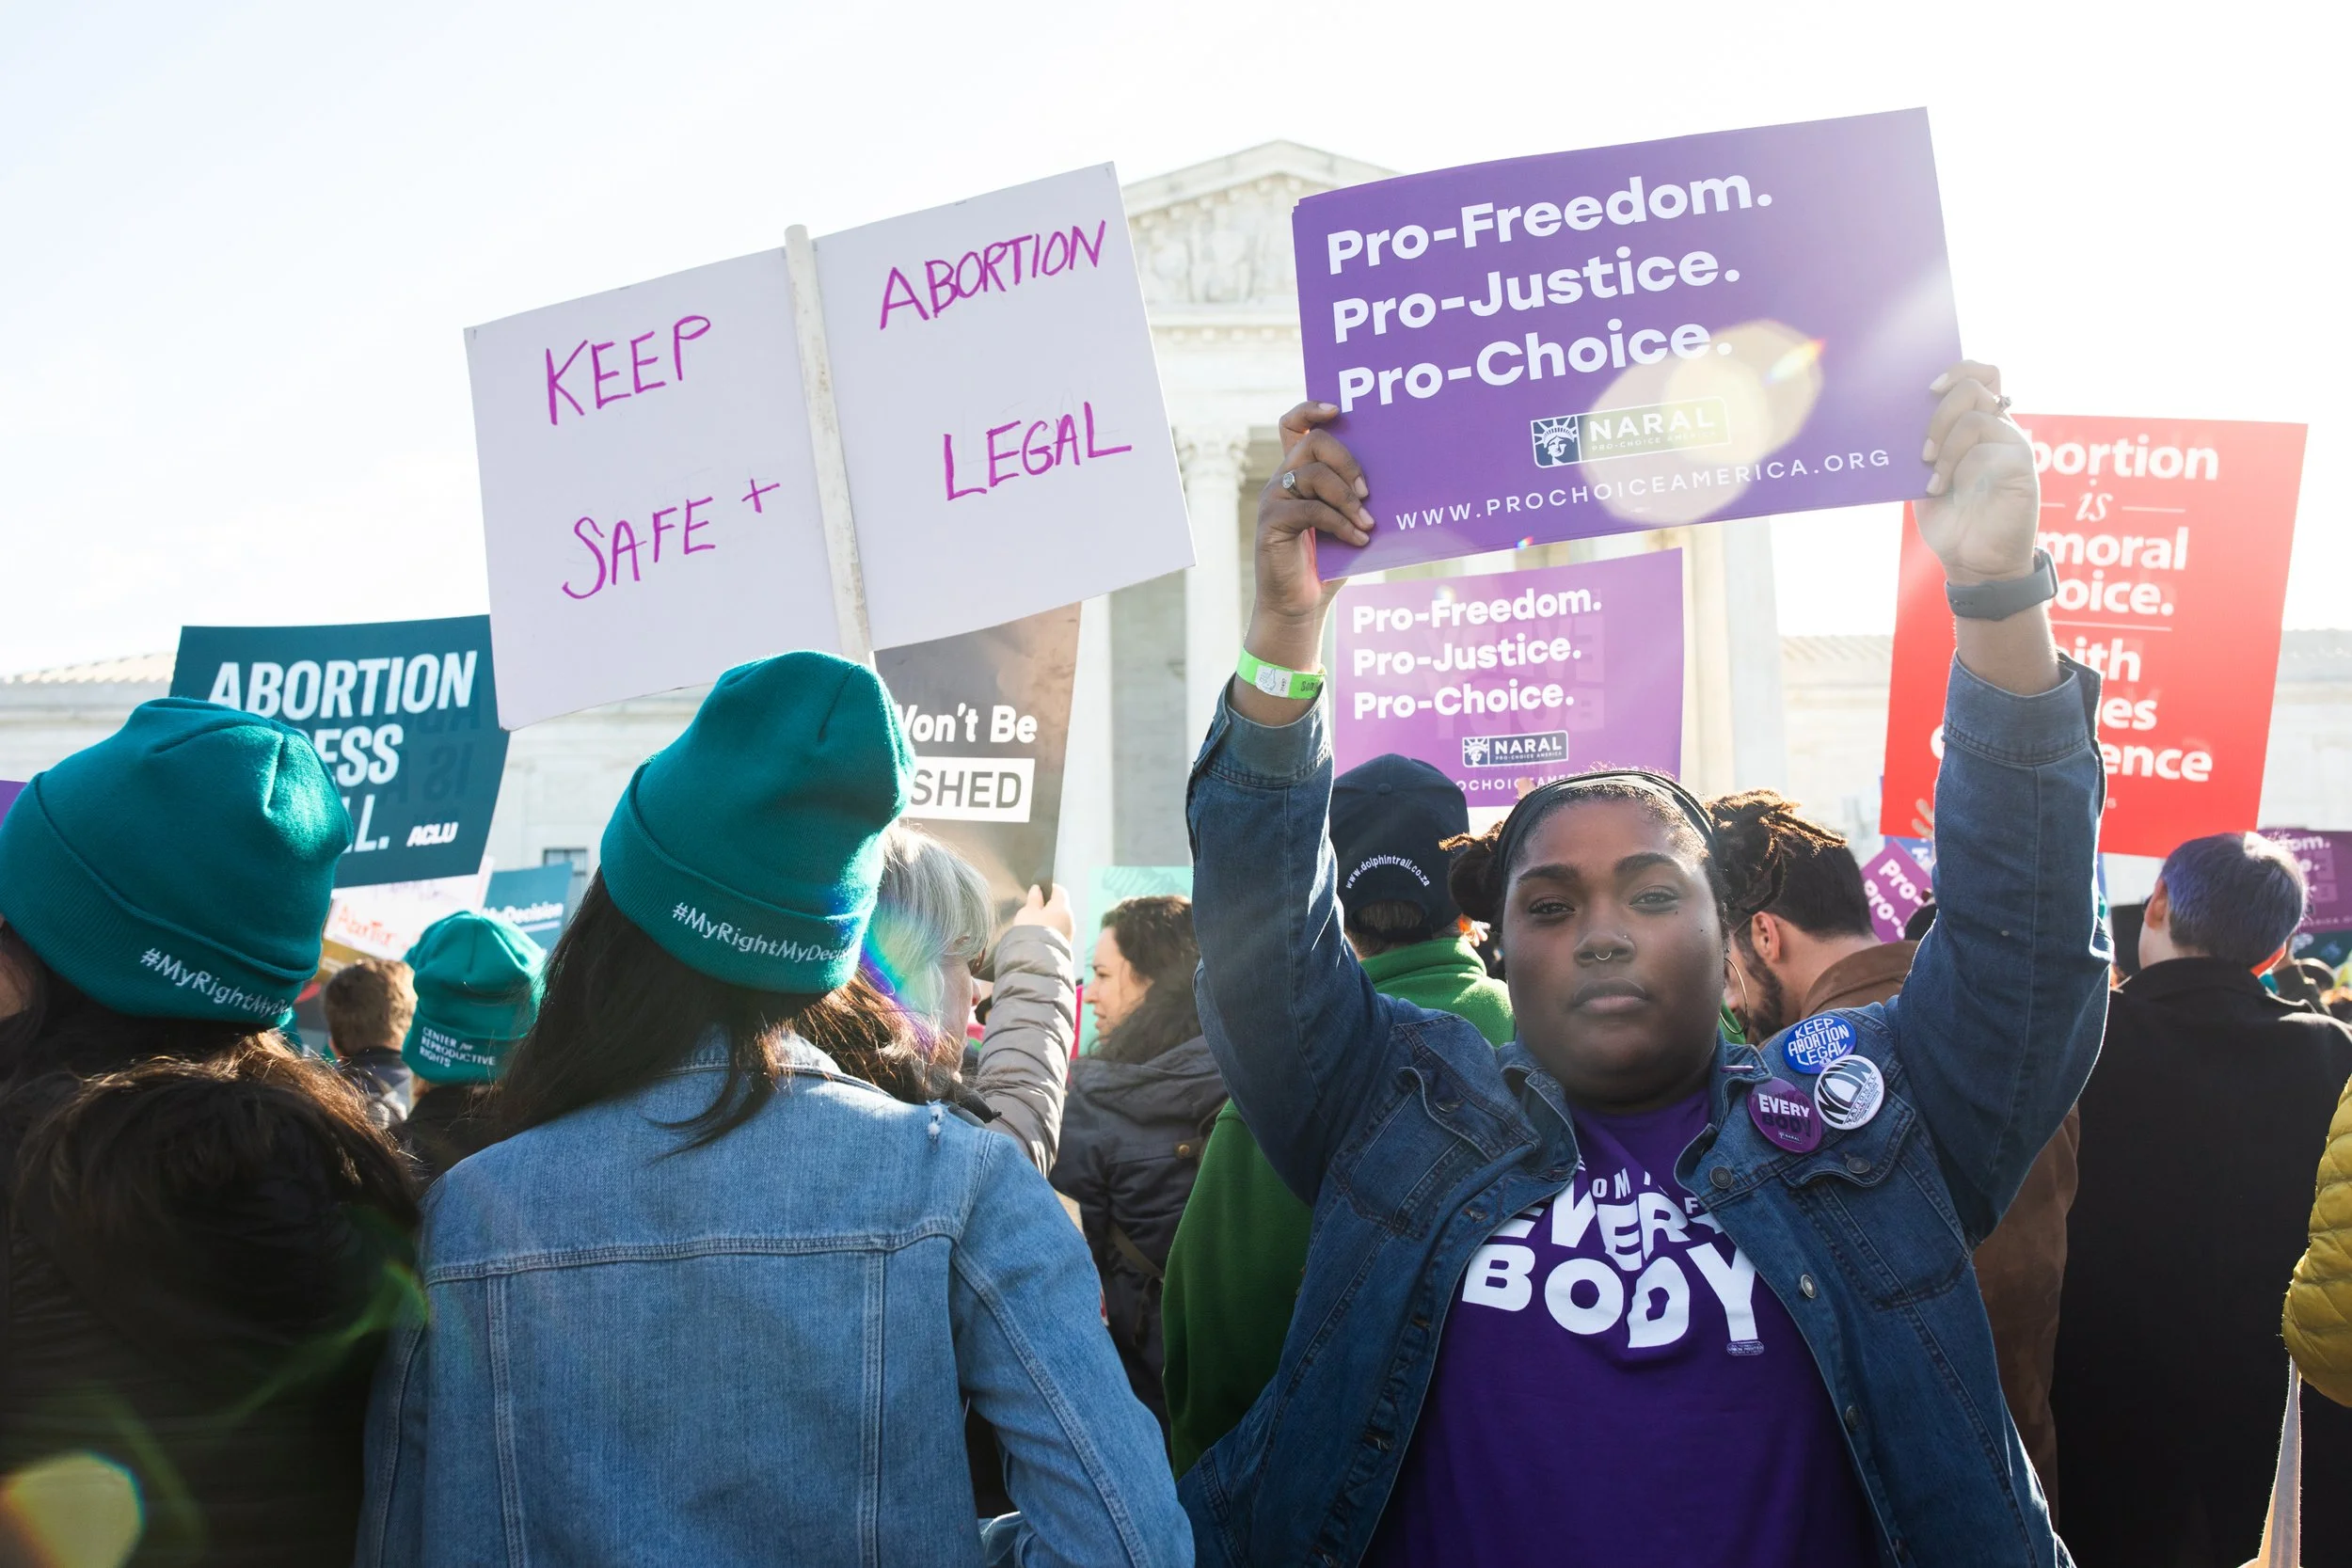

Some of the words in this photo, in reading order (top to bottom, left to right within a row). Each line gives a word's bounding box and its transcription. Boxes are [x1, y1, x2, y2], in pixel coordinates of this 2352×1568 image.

[1327, 175, 1772, 275] Pro-Freedom.
[880, 220, 1105, 329] ABORTION
[1333, 245, 1740, 343] Pro-Justice.
[546, 315, 710, 425] KEEP
[1338, 318, 1732, 413] Pro-Choice.
[1590, 407, 1715, 441] NARAL
[1591, 437, 1661, 451] PRO-CHOICE
[943, 402, 1132, 501] LEGAL
[2026, 429, 2218, 481] bortion
[1396, 449, 1890, 531] WWW.PROCHOICEAMERICA.ORG
[2075, 478, 2114, 522] is
[564, 497, 715, 598] SAFE
[2036, 527, 2189, 570] moral
[1353, 588, 1602, 633] Pro-Freedom.
[2047, 570, 2174, 616] oice.
[1354, 632, 1581, 676] Pro-Justice.
[208, 650, 478, 721] ABORTION
[1354, 678, 1574, 721] Pro-Choice.
[990, 705, 1038, 743] Be
[1495, 736, 1563, 754] NARAL
[910, 769, 1022, 809] SHED
[406, 822, 459, 847] ACLU
[1346, 854, 1430, 889] www.dolphintrail.co.za
[422, 1026, 458, 1048] CENTER
[1788, 1024, 1850, 1056] ABORTION
[1795, 1018, 1835, 1038] KEEP
[420, 1048, 452, 1068] RIGHTS
[421, 1036, 497, 1067] REPRODUCTIVE
[1796, 1041, 1847, 1066] LEGAL
[1758, 1093, 1809, 1117] EVERY
[1818, 1059, 1874, 1125] NOW
[1761, 1114, 1811, 1137] BODY
[1462, 1243, 1758, 1348] BODY
